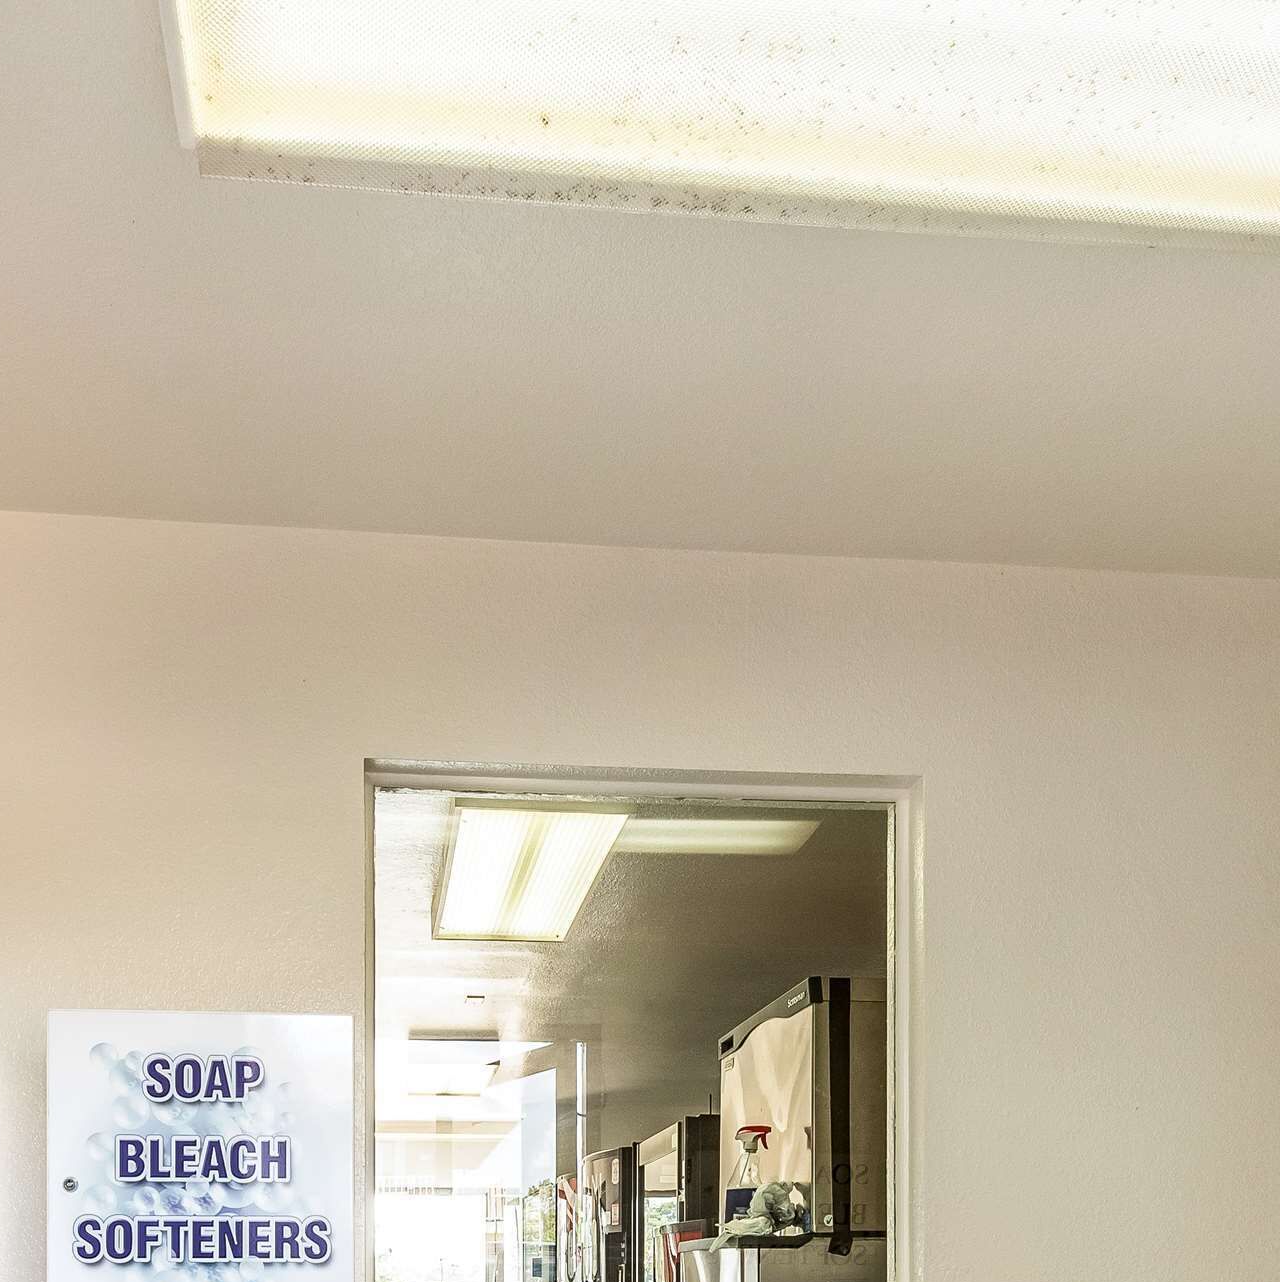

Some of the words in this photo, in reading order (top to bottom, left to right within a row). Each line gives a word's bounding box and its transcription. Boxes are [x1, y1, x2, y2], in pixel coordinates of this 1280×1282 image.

[144, 1056, 263, 1100] SOAP
[117, 1137, 289, 1181] BLEACH
[74, 1217, 330, 1261] SOFTENERS
